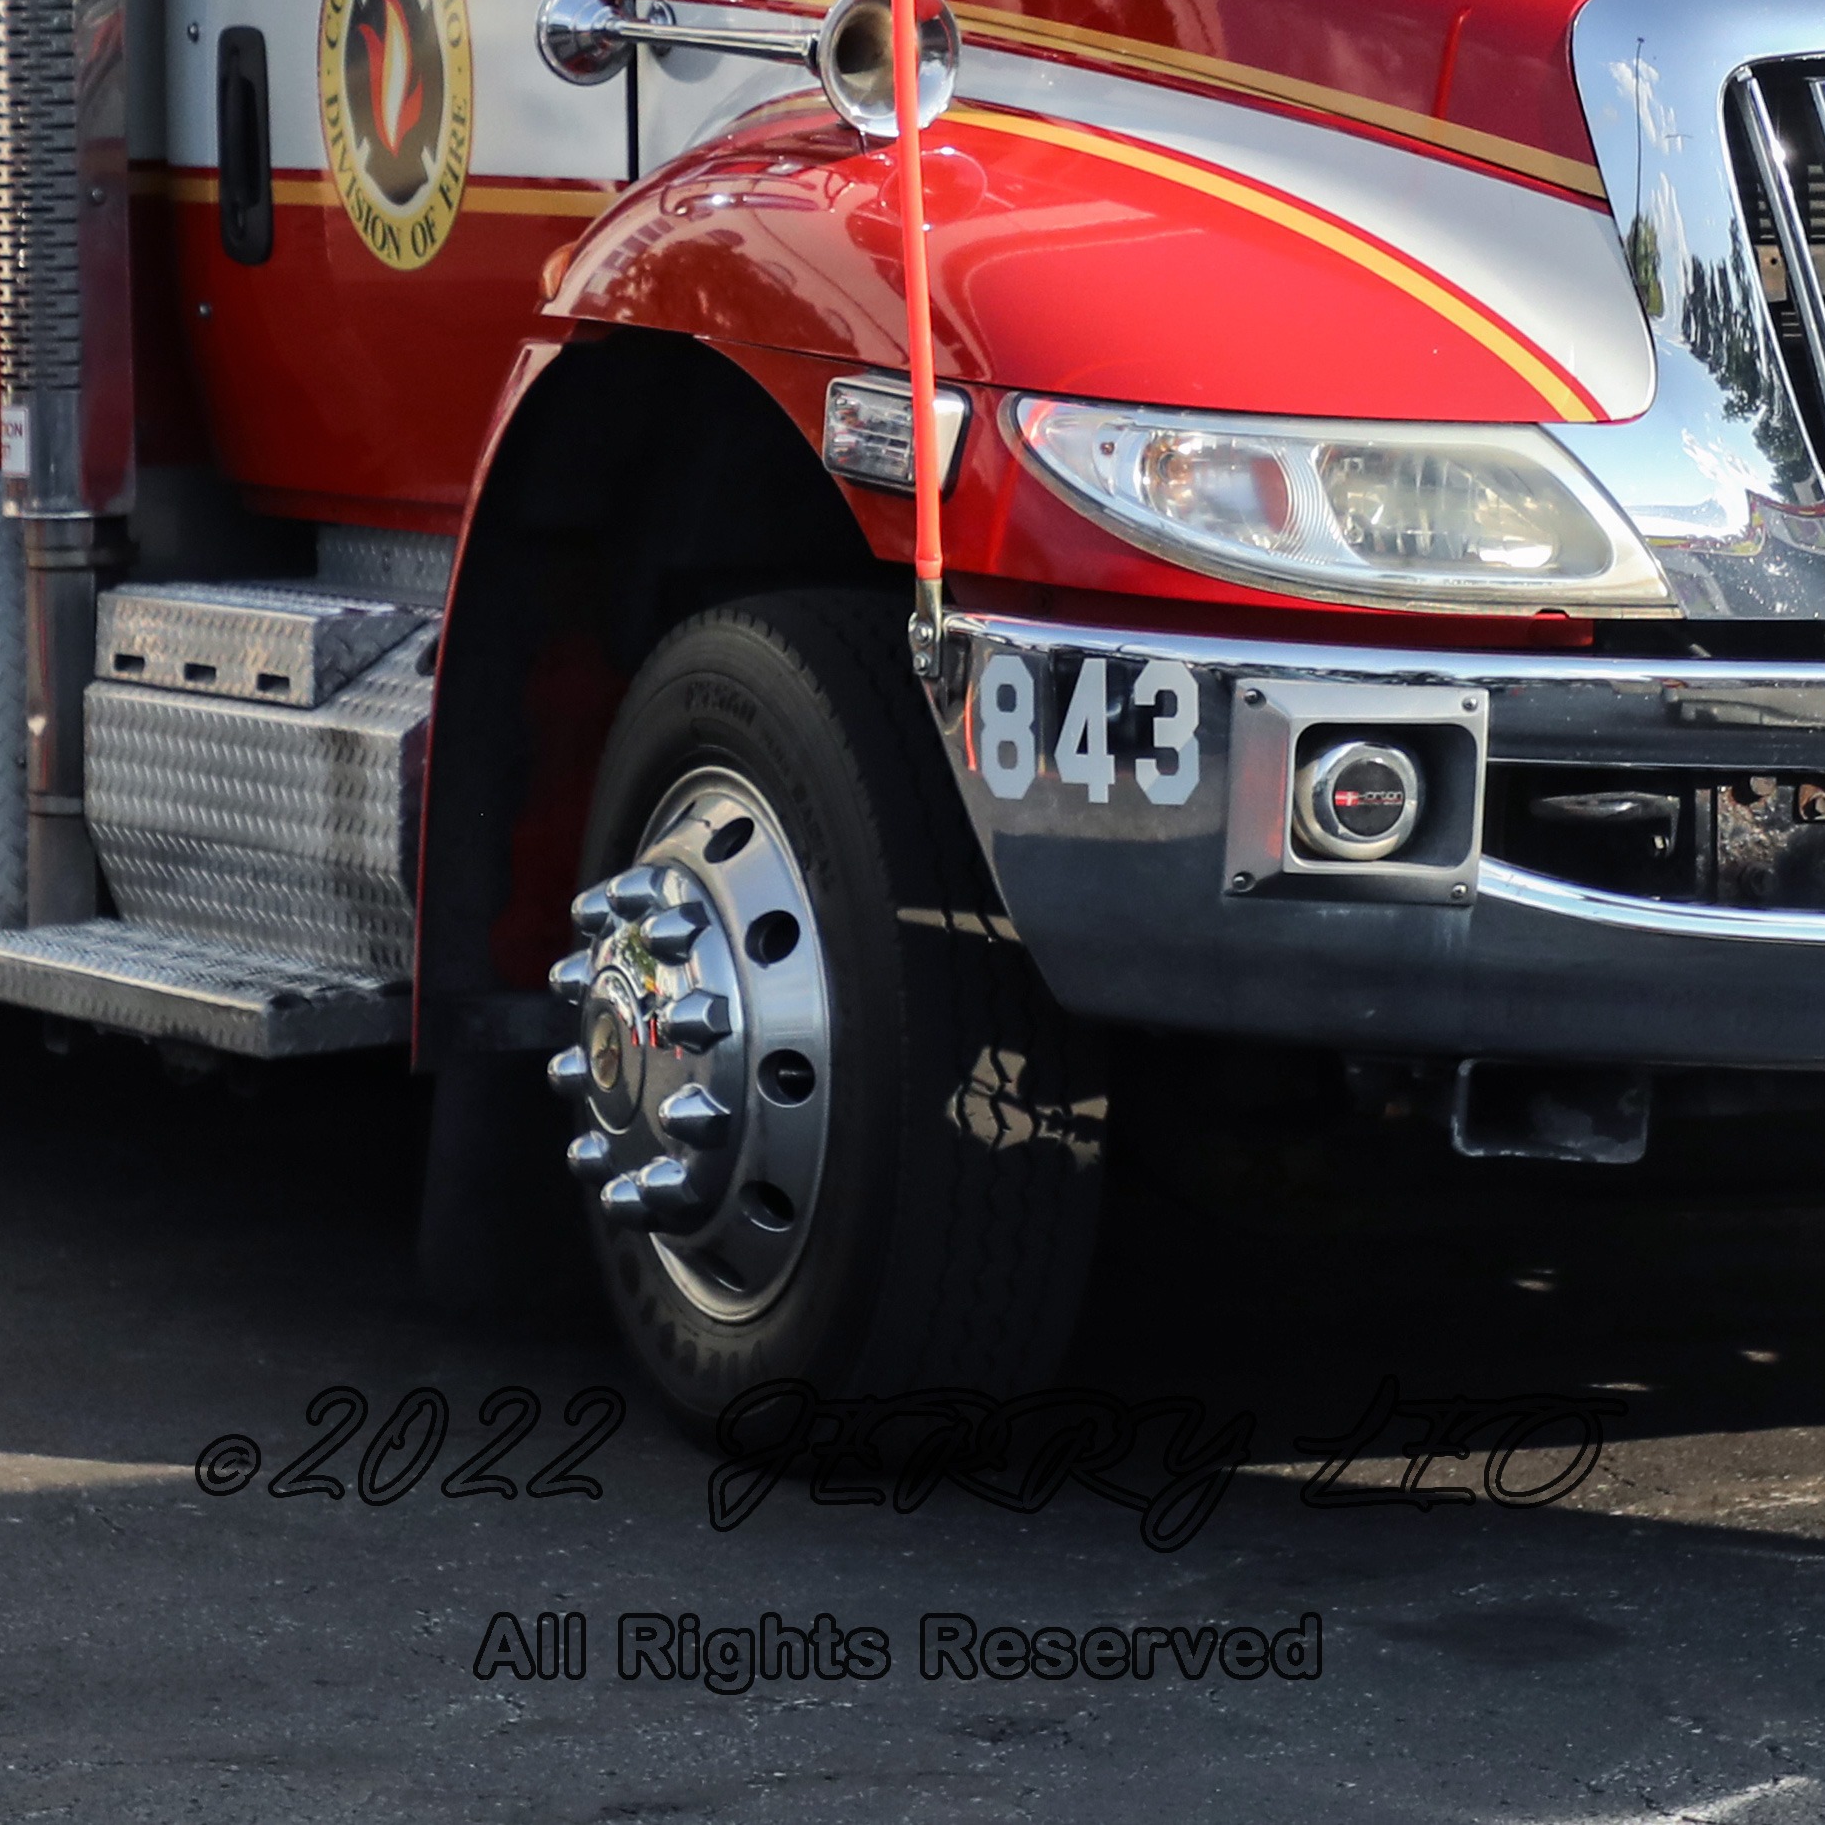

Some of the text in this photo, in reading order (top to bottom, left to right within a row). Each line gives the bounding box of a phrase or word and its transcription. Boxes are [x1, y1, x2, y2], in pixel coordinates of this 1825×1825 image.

[327, 94, 467, 261] DIVISION OF FIRE
[980, 654, 1200, 805] 843
